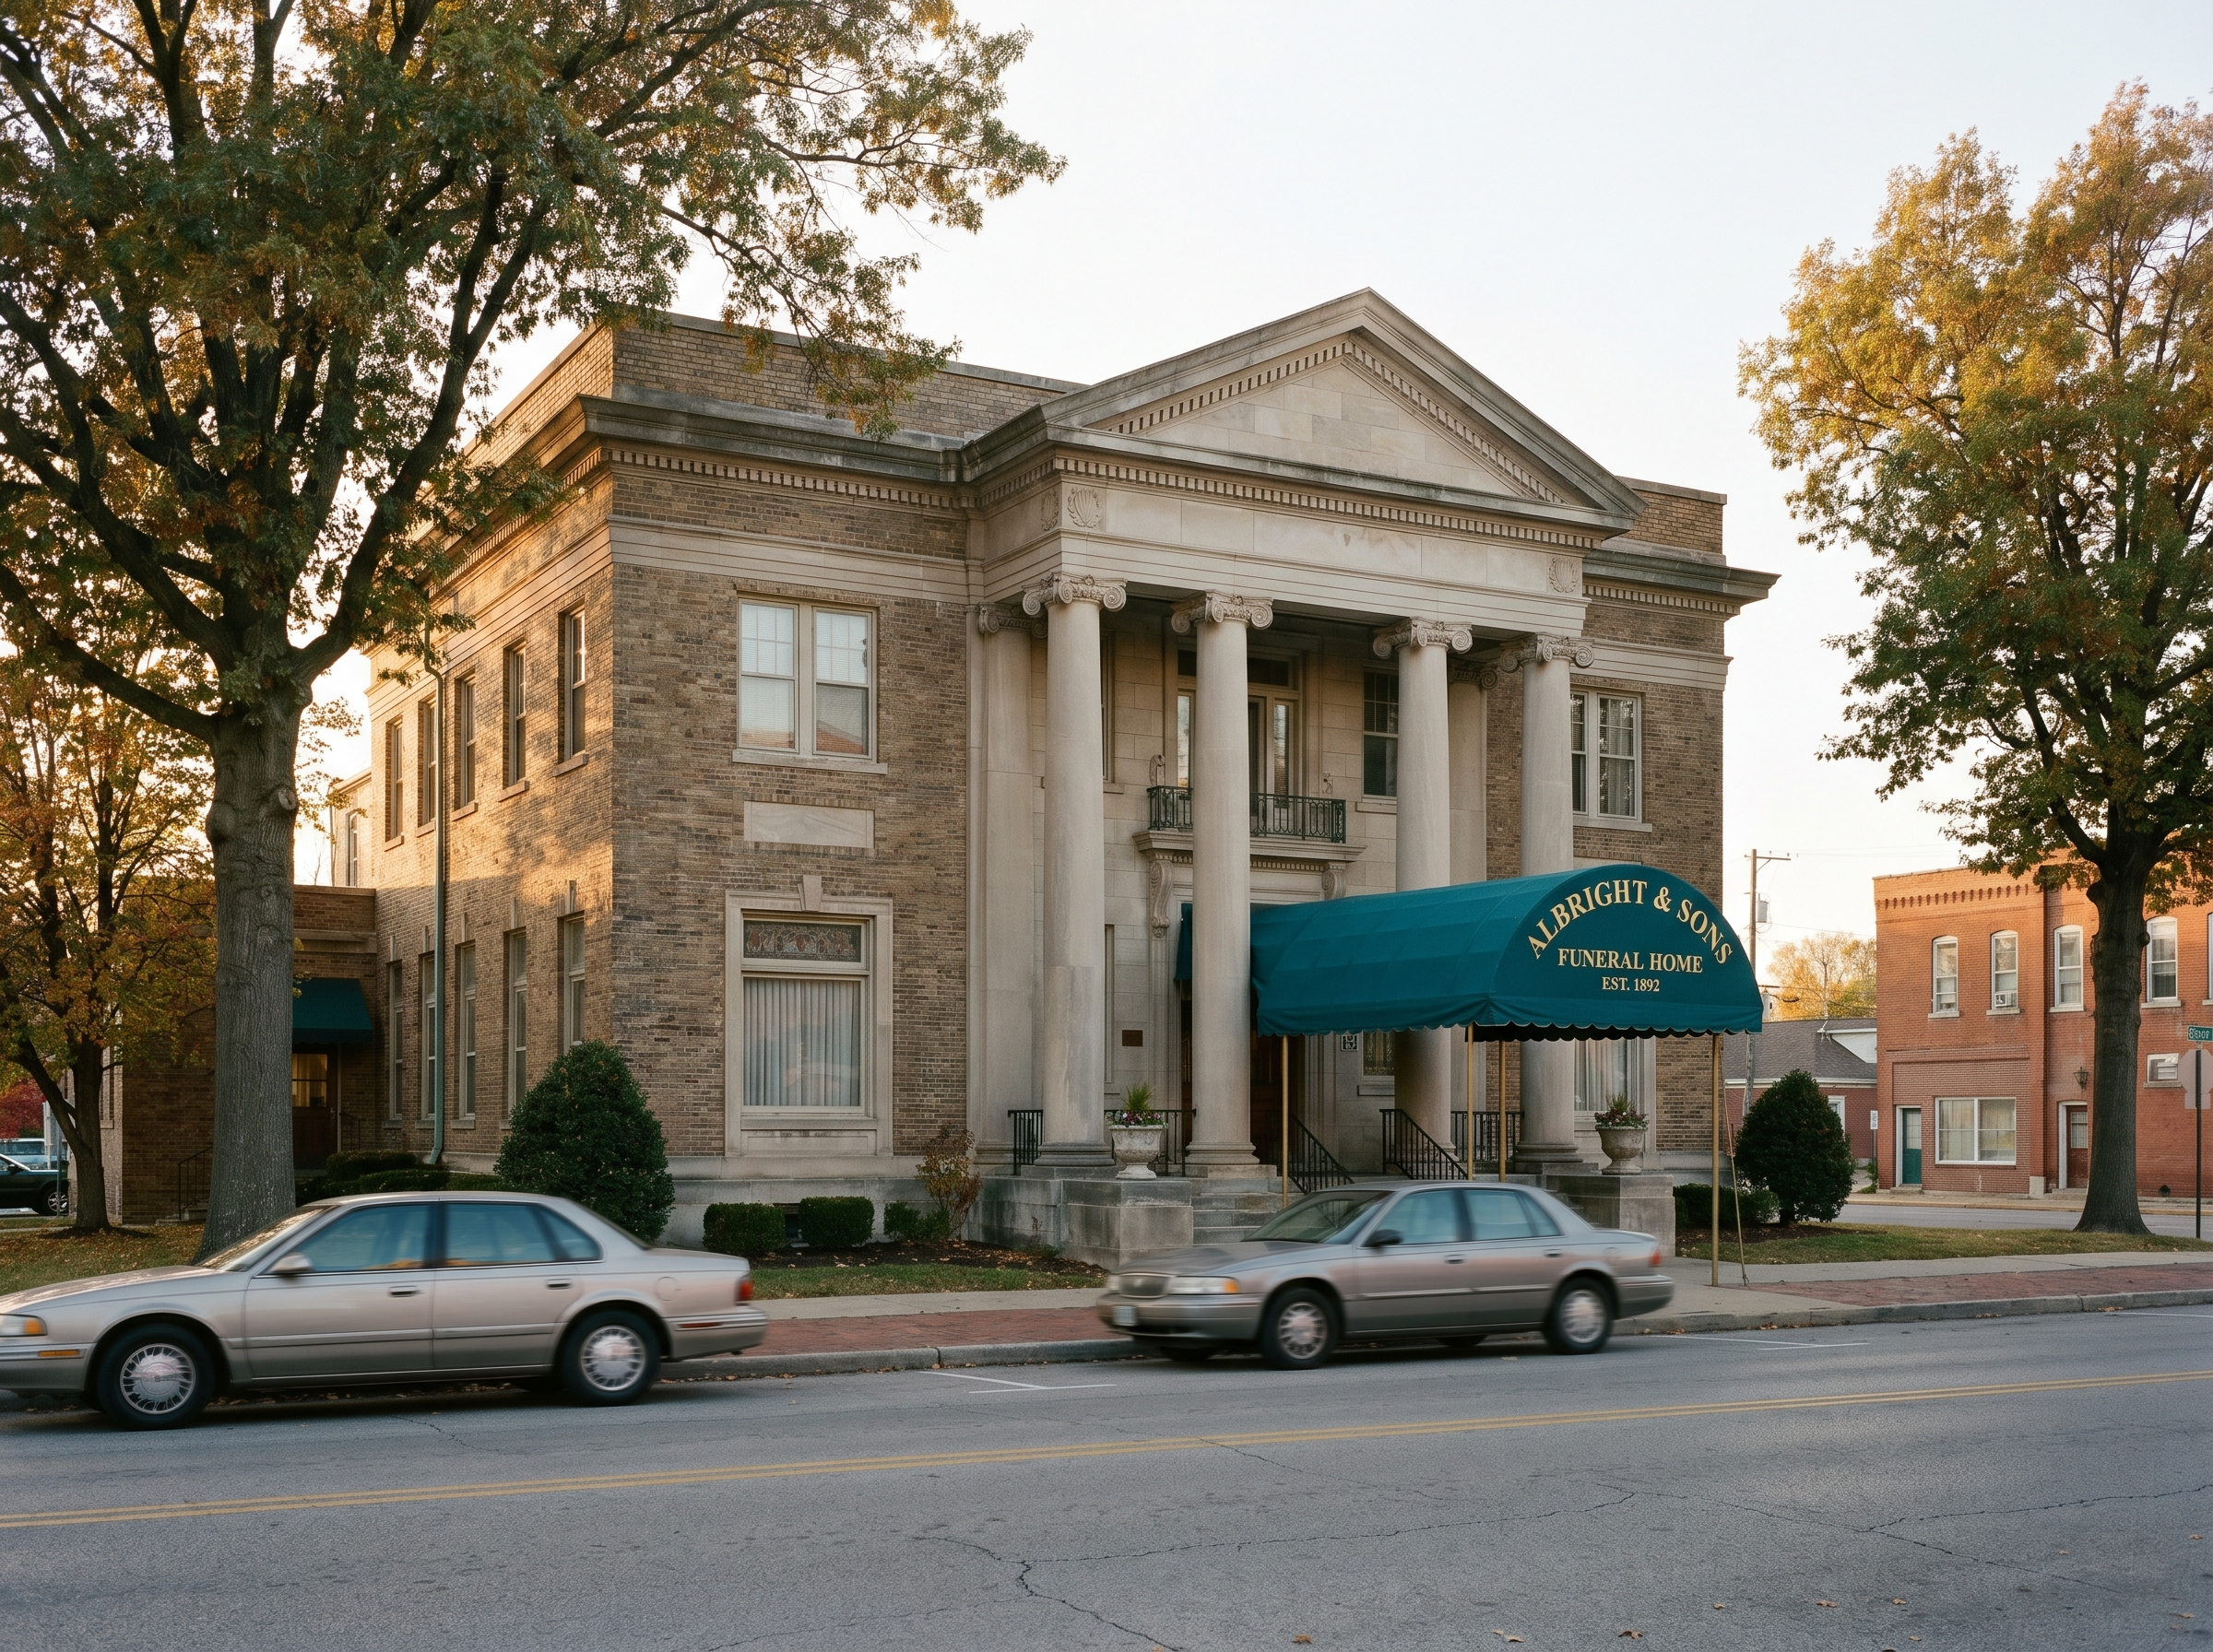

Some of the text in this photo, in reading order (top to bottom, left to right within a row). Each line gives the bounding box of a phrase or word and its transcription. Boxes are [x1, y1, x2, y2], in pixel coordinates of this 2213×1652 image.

[1528, 879, 1734, 964] ALBRIGHT & SONS
[1557, 948, 1703, 974] FUNERAL HOME
[1602, 976, 1660, 992] EST. 1892
